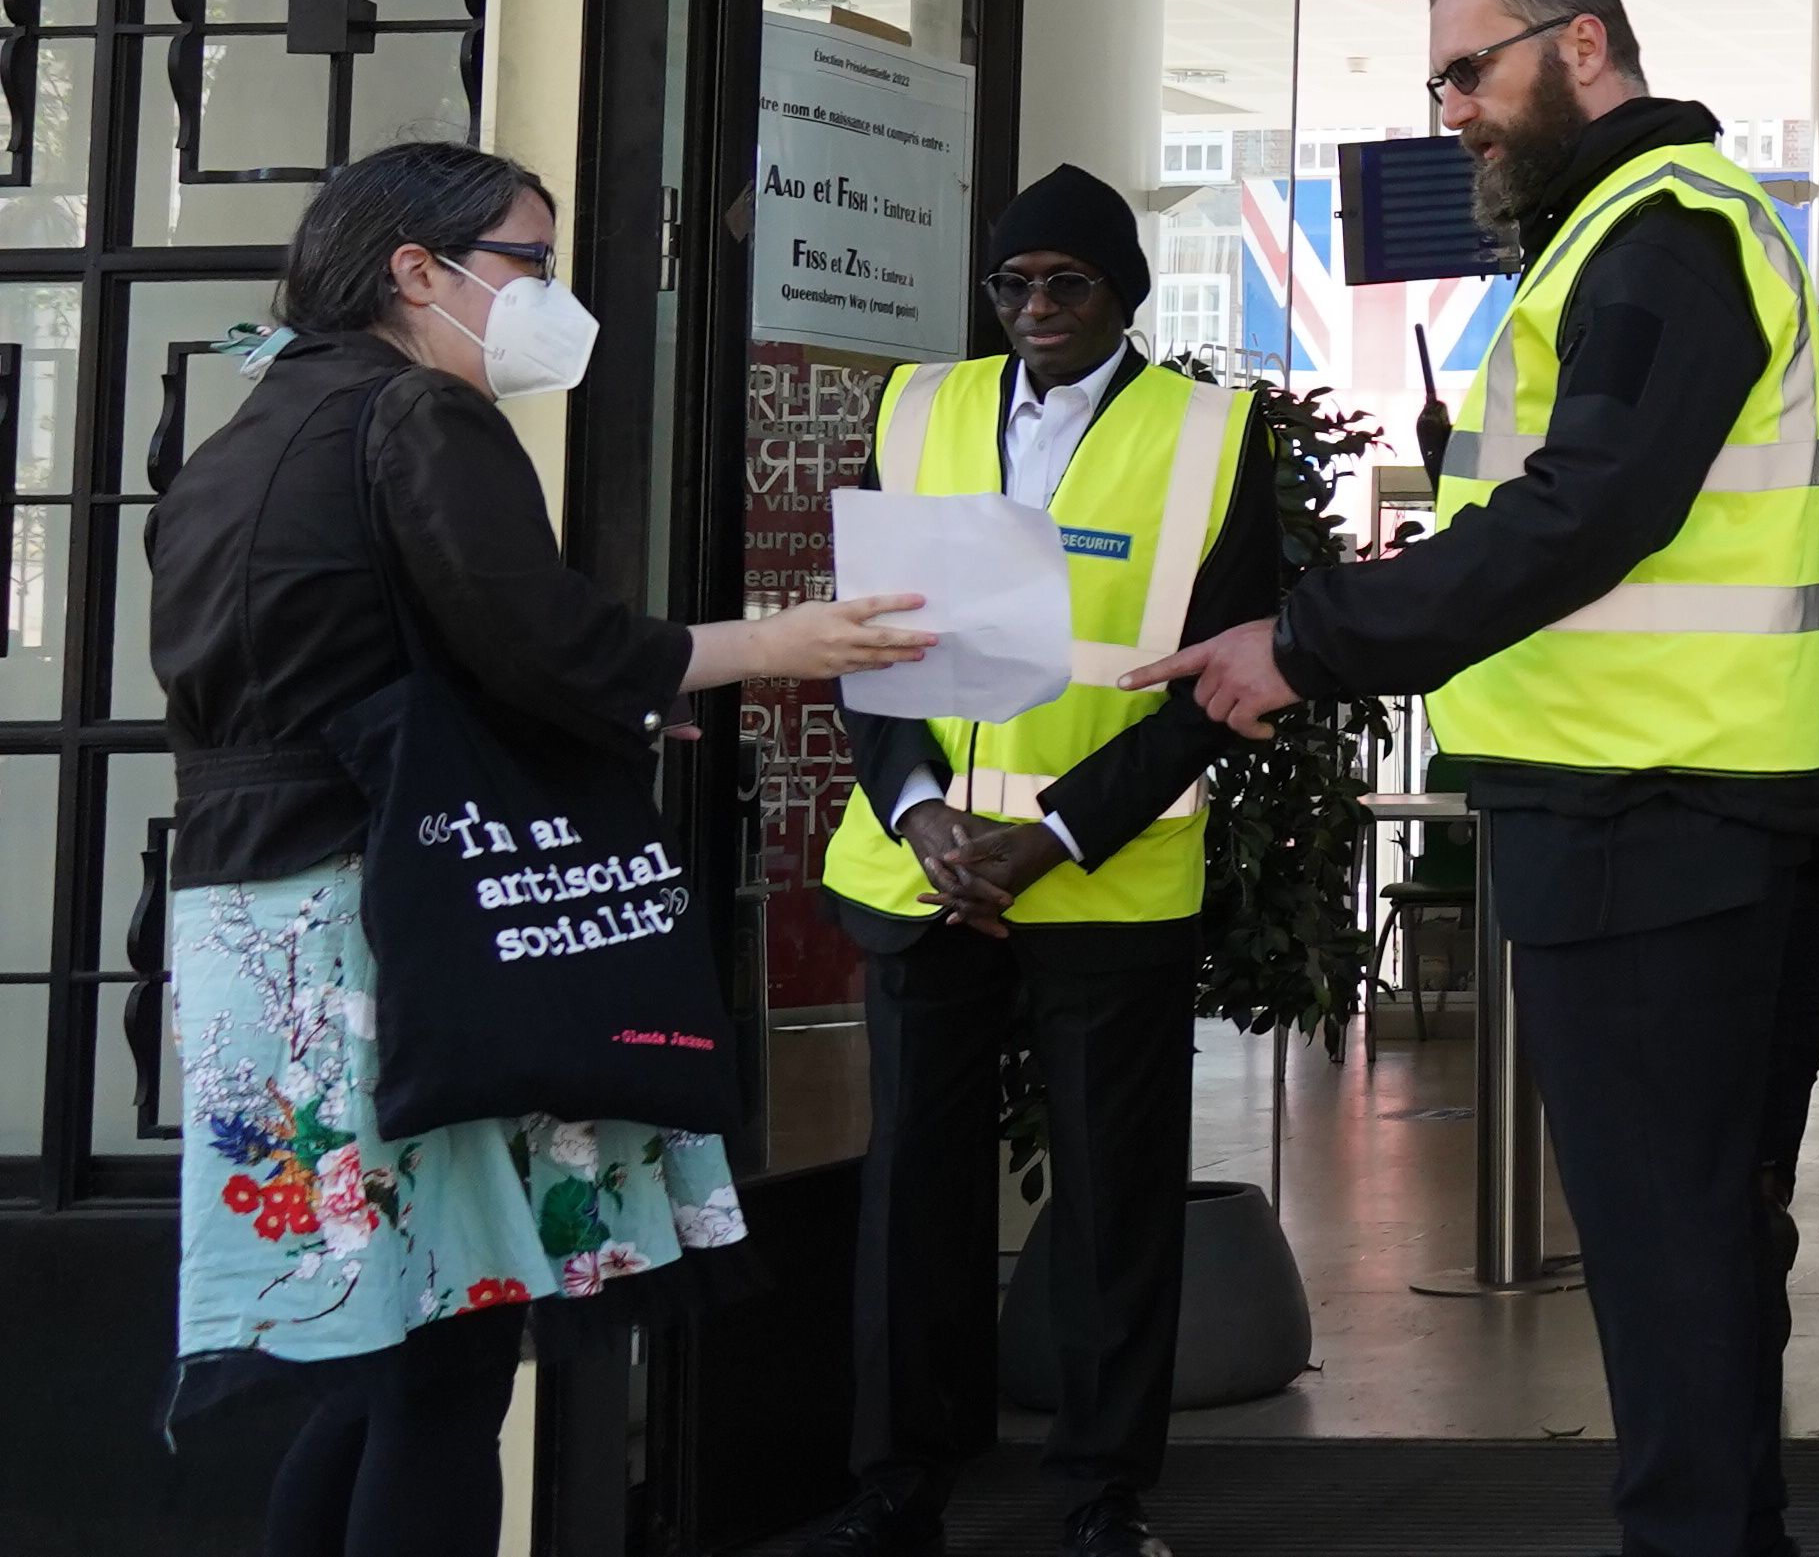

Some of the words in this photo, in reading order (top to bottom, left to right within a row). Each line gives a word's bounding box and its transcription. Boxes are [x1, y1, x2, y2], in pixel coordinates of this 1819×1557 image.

[758, 95, 779, 112] tre
[783, 101, 810, 117] nom
[813, 105, 827, 121] de
[828, 110, 871, 133] naissance
[872, 123, 885, 137] est
[887, 128, 920, 145] compris
[921, 135, 944, 152] entre
[813, 178, 831, 205] et
[883, 198, 917, 224] Entrez
[918, 207, 932, 227] ici
[831, 256, 843, 274] et
[881, 268, 907, 286] Entrez
[781, 283, 846, 310] Queensberry
[849, 294, 868, 314] Way
[1061, 533, 1126, 553] SECURITY
